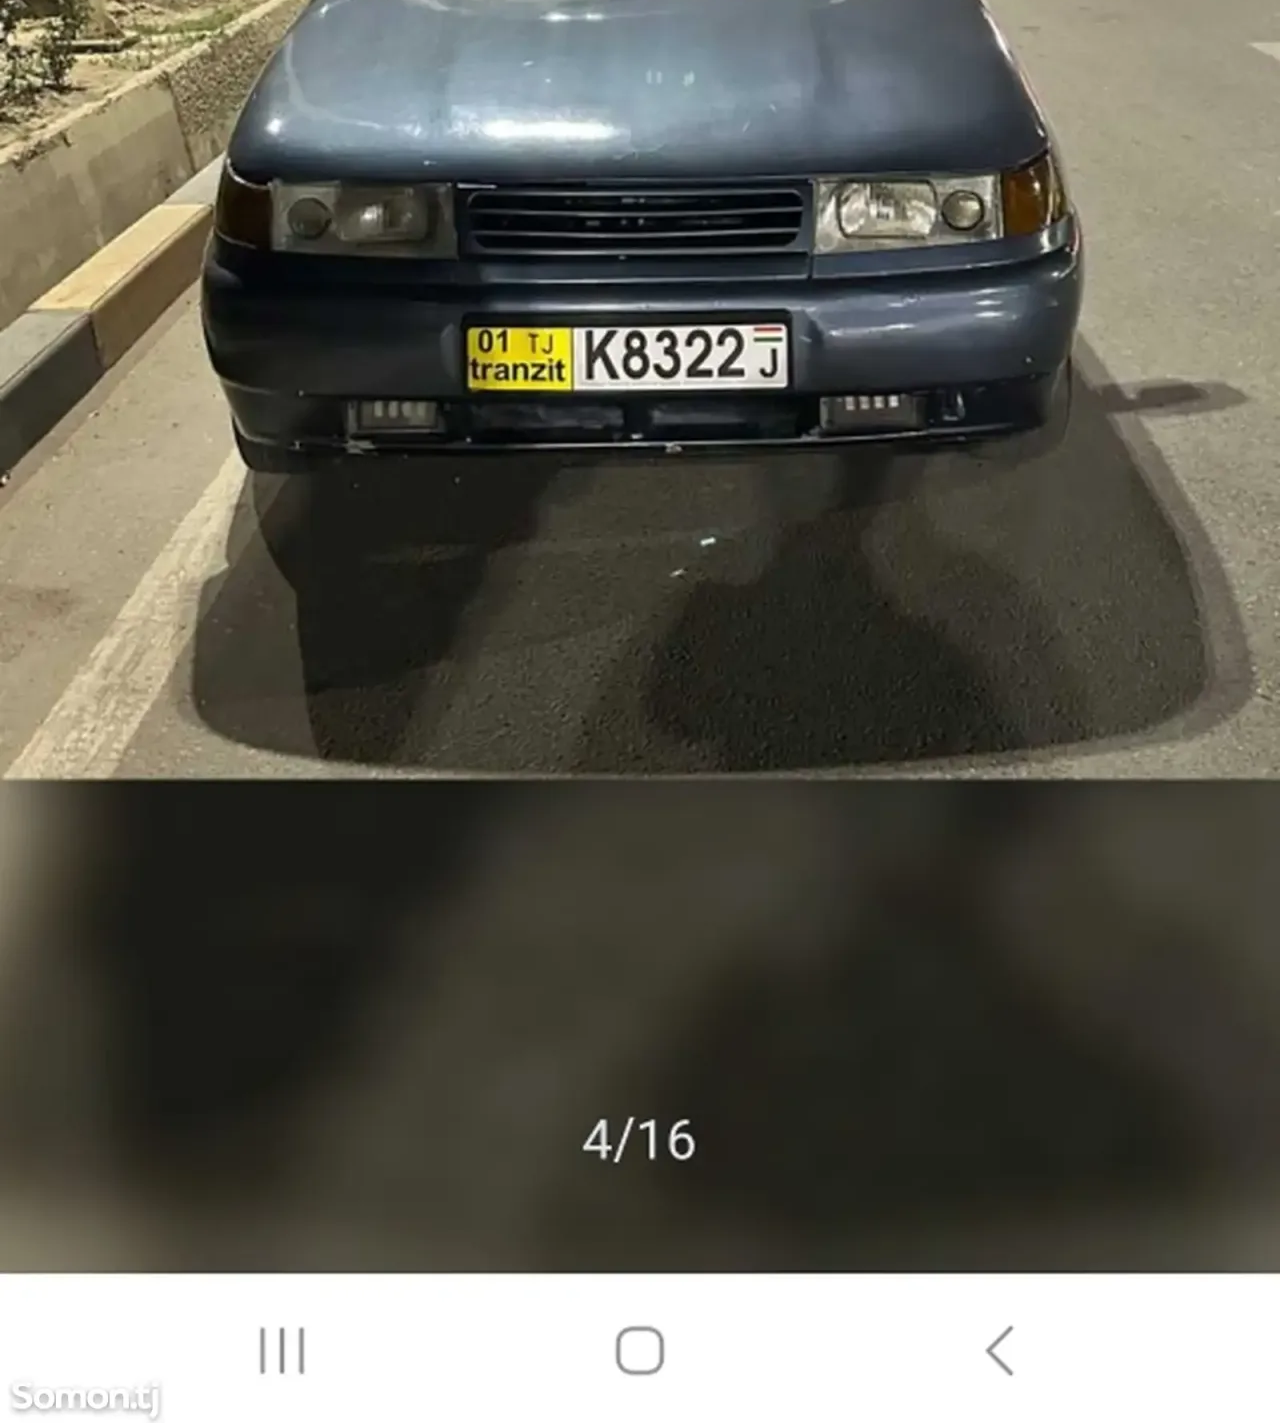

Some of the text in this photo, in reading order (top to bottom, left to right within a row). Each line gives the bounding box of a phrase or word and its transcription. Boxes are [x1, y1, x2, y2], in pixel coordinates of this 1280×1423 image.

[477, 330, 554, 355] 01 TJ
[585, 328, 745, 379] K8322
[470, 358, 565, 382] tranzit
